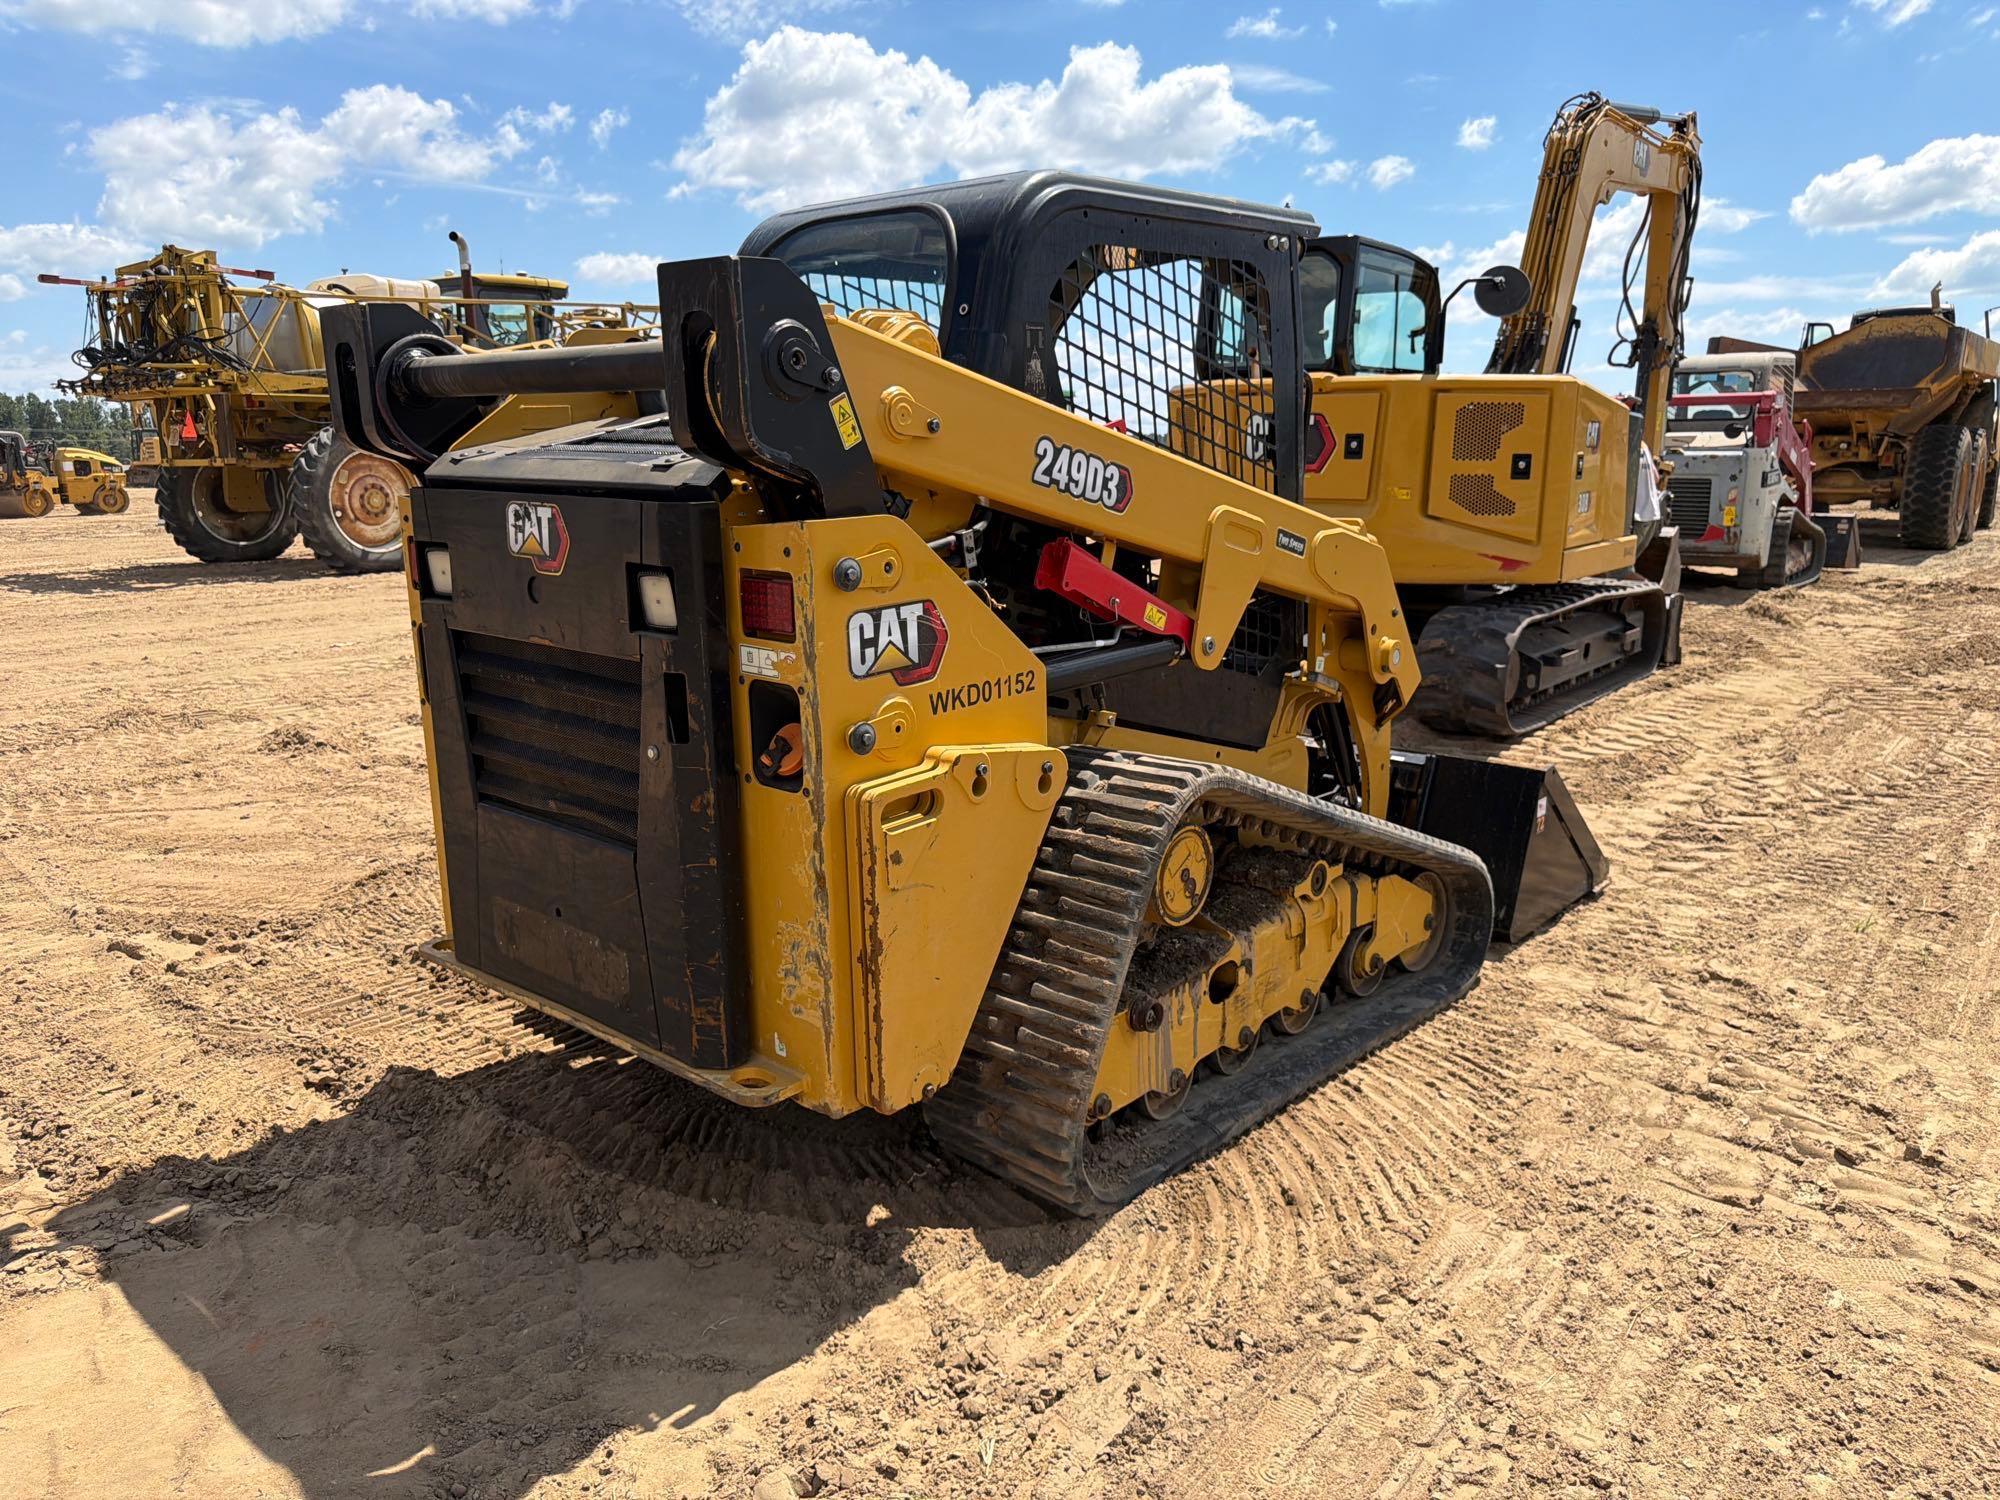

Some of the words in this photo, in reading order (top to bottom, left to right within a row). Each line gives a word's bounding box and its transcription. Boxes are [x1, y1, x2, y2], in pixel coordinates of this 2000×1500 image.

[1033, 438, 1120, 507] 249D3
[508, 503, 552, 557] CAT
[849, 602, 924, 677] CAT
[928, 669, 1036, 716] WKD01152
